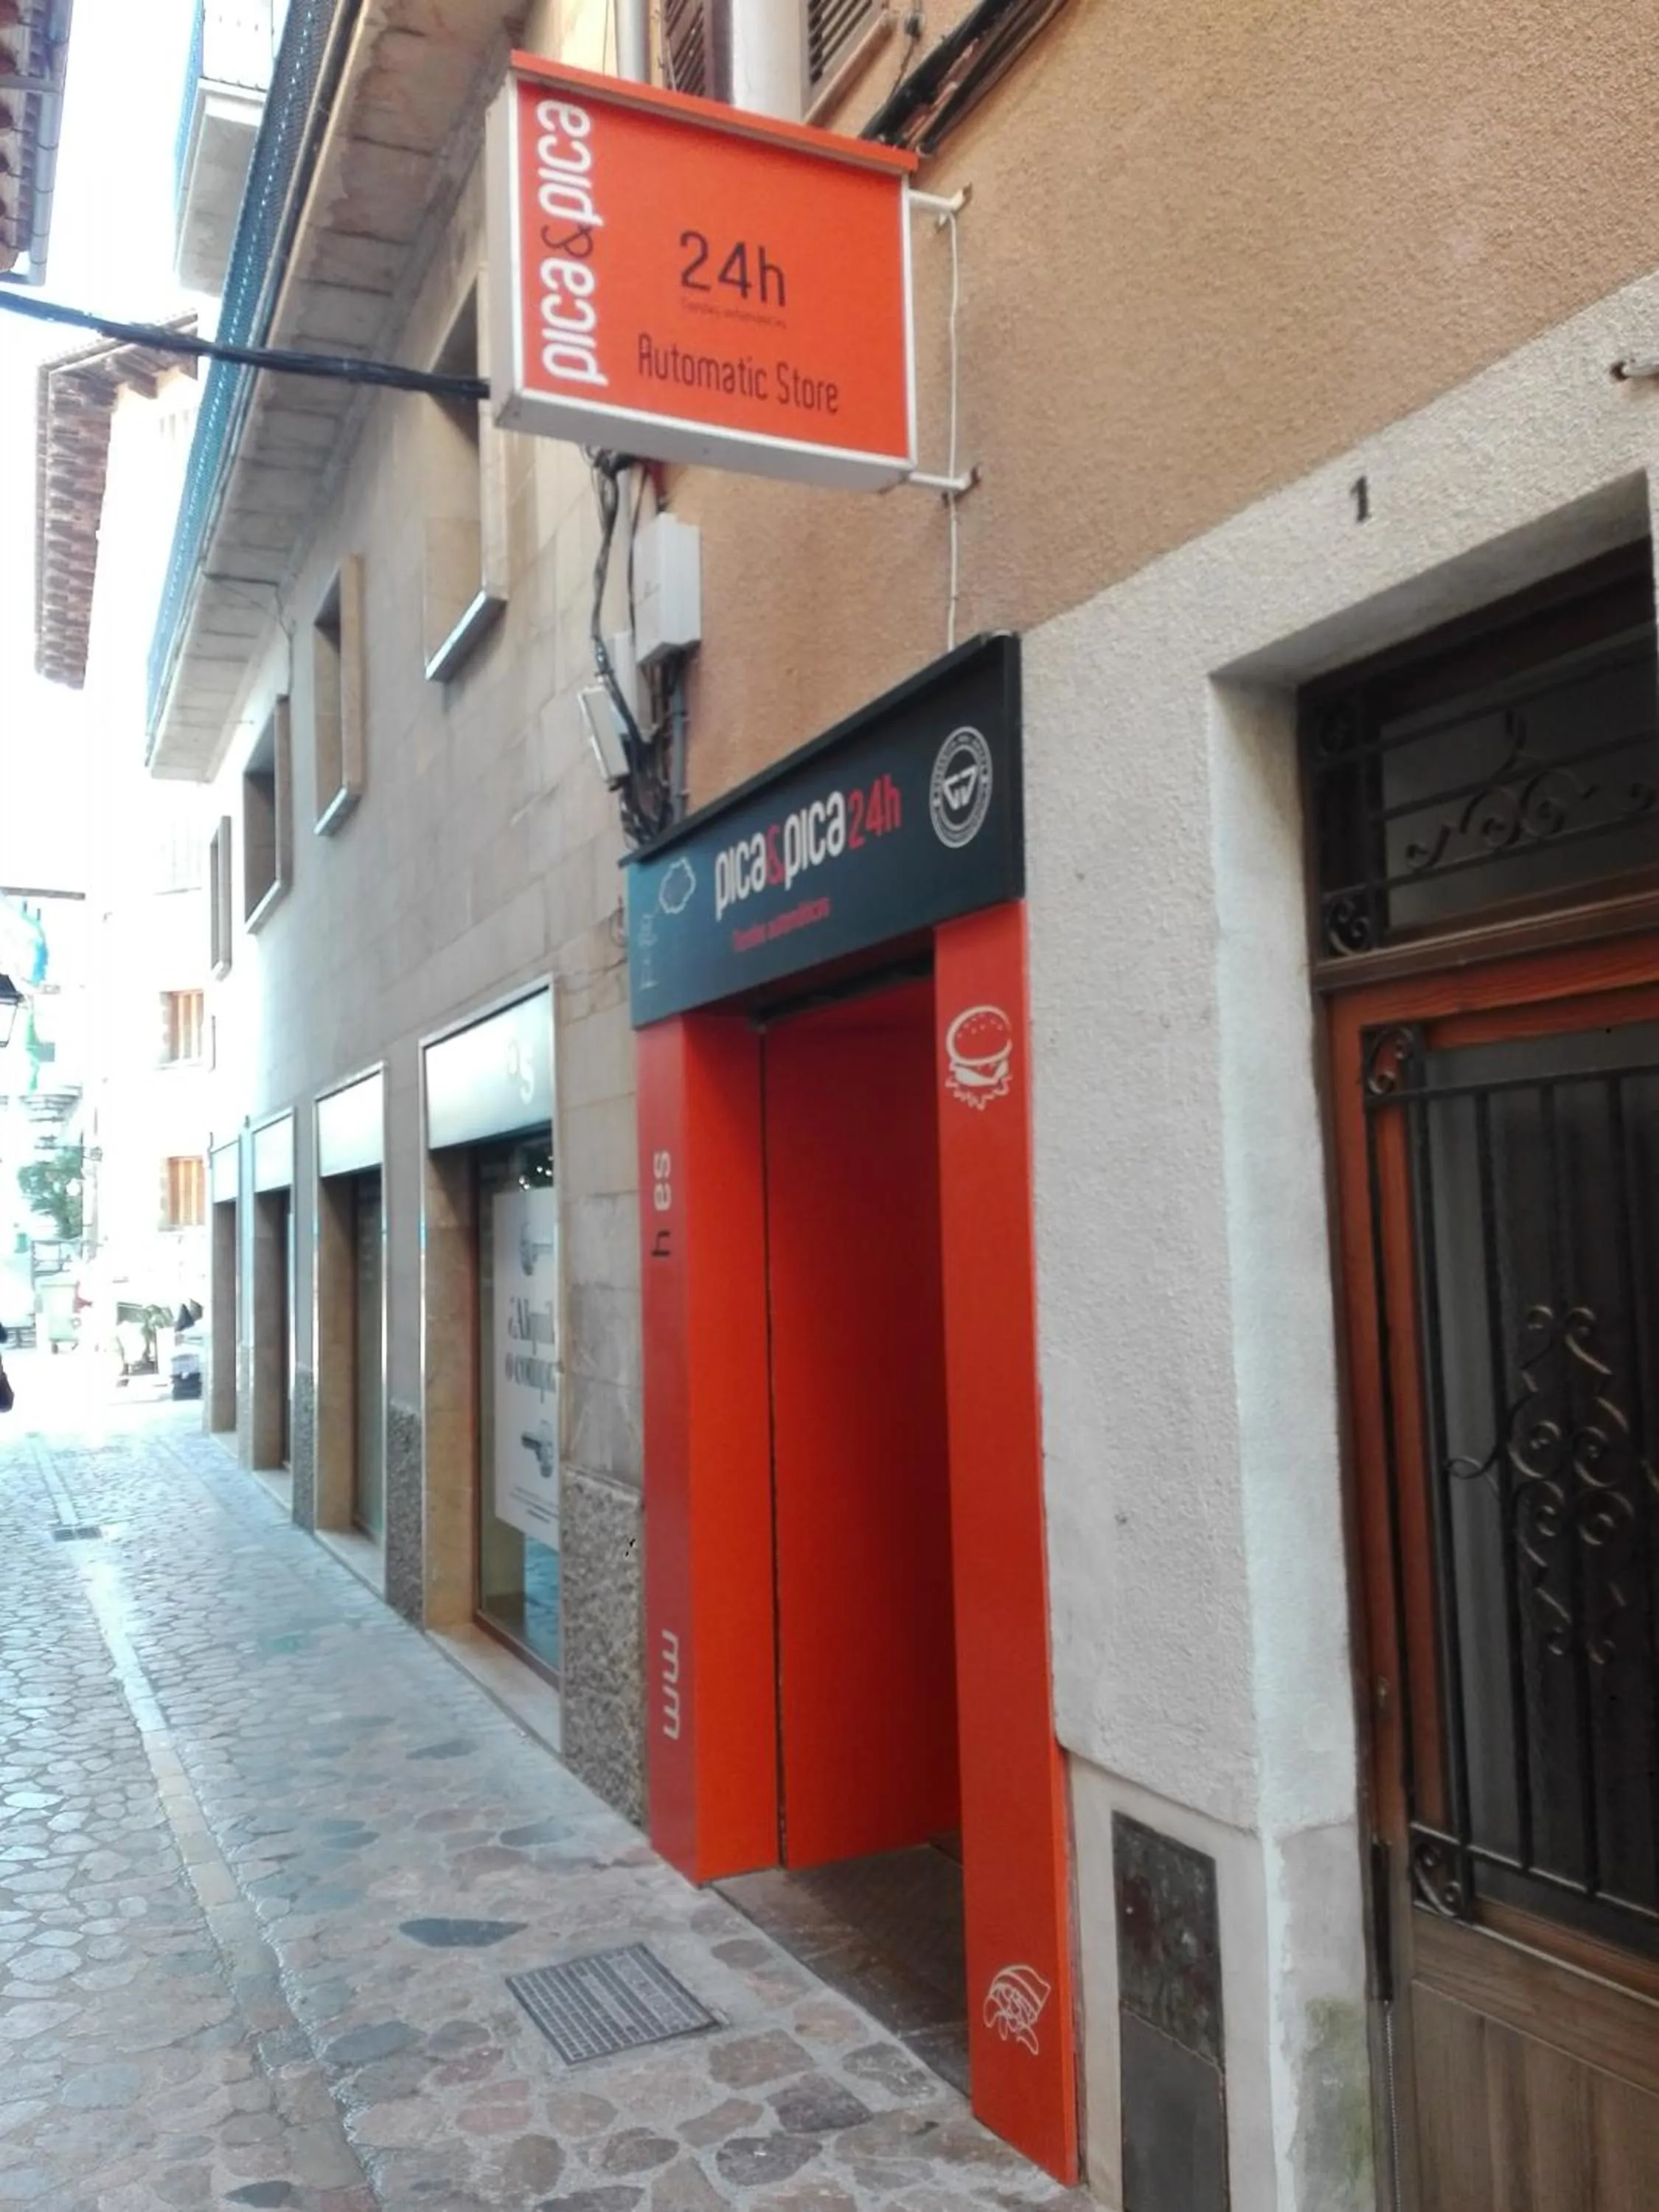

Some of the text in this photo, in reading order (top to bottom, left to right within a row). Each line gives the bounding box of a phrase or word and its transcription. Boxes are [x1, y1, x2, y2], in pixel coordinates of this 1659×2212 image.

[679, 230, 786, 307] 24h
[638, 332, 839, 415] Automatic Store
[1350, 476, 1370, 523] 1
